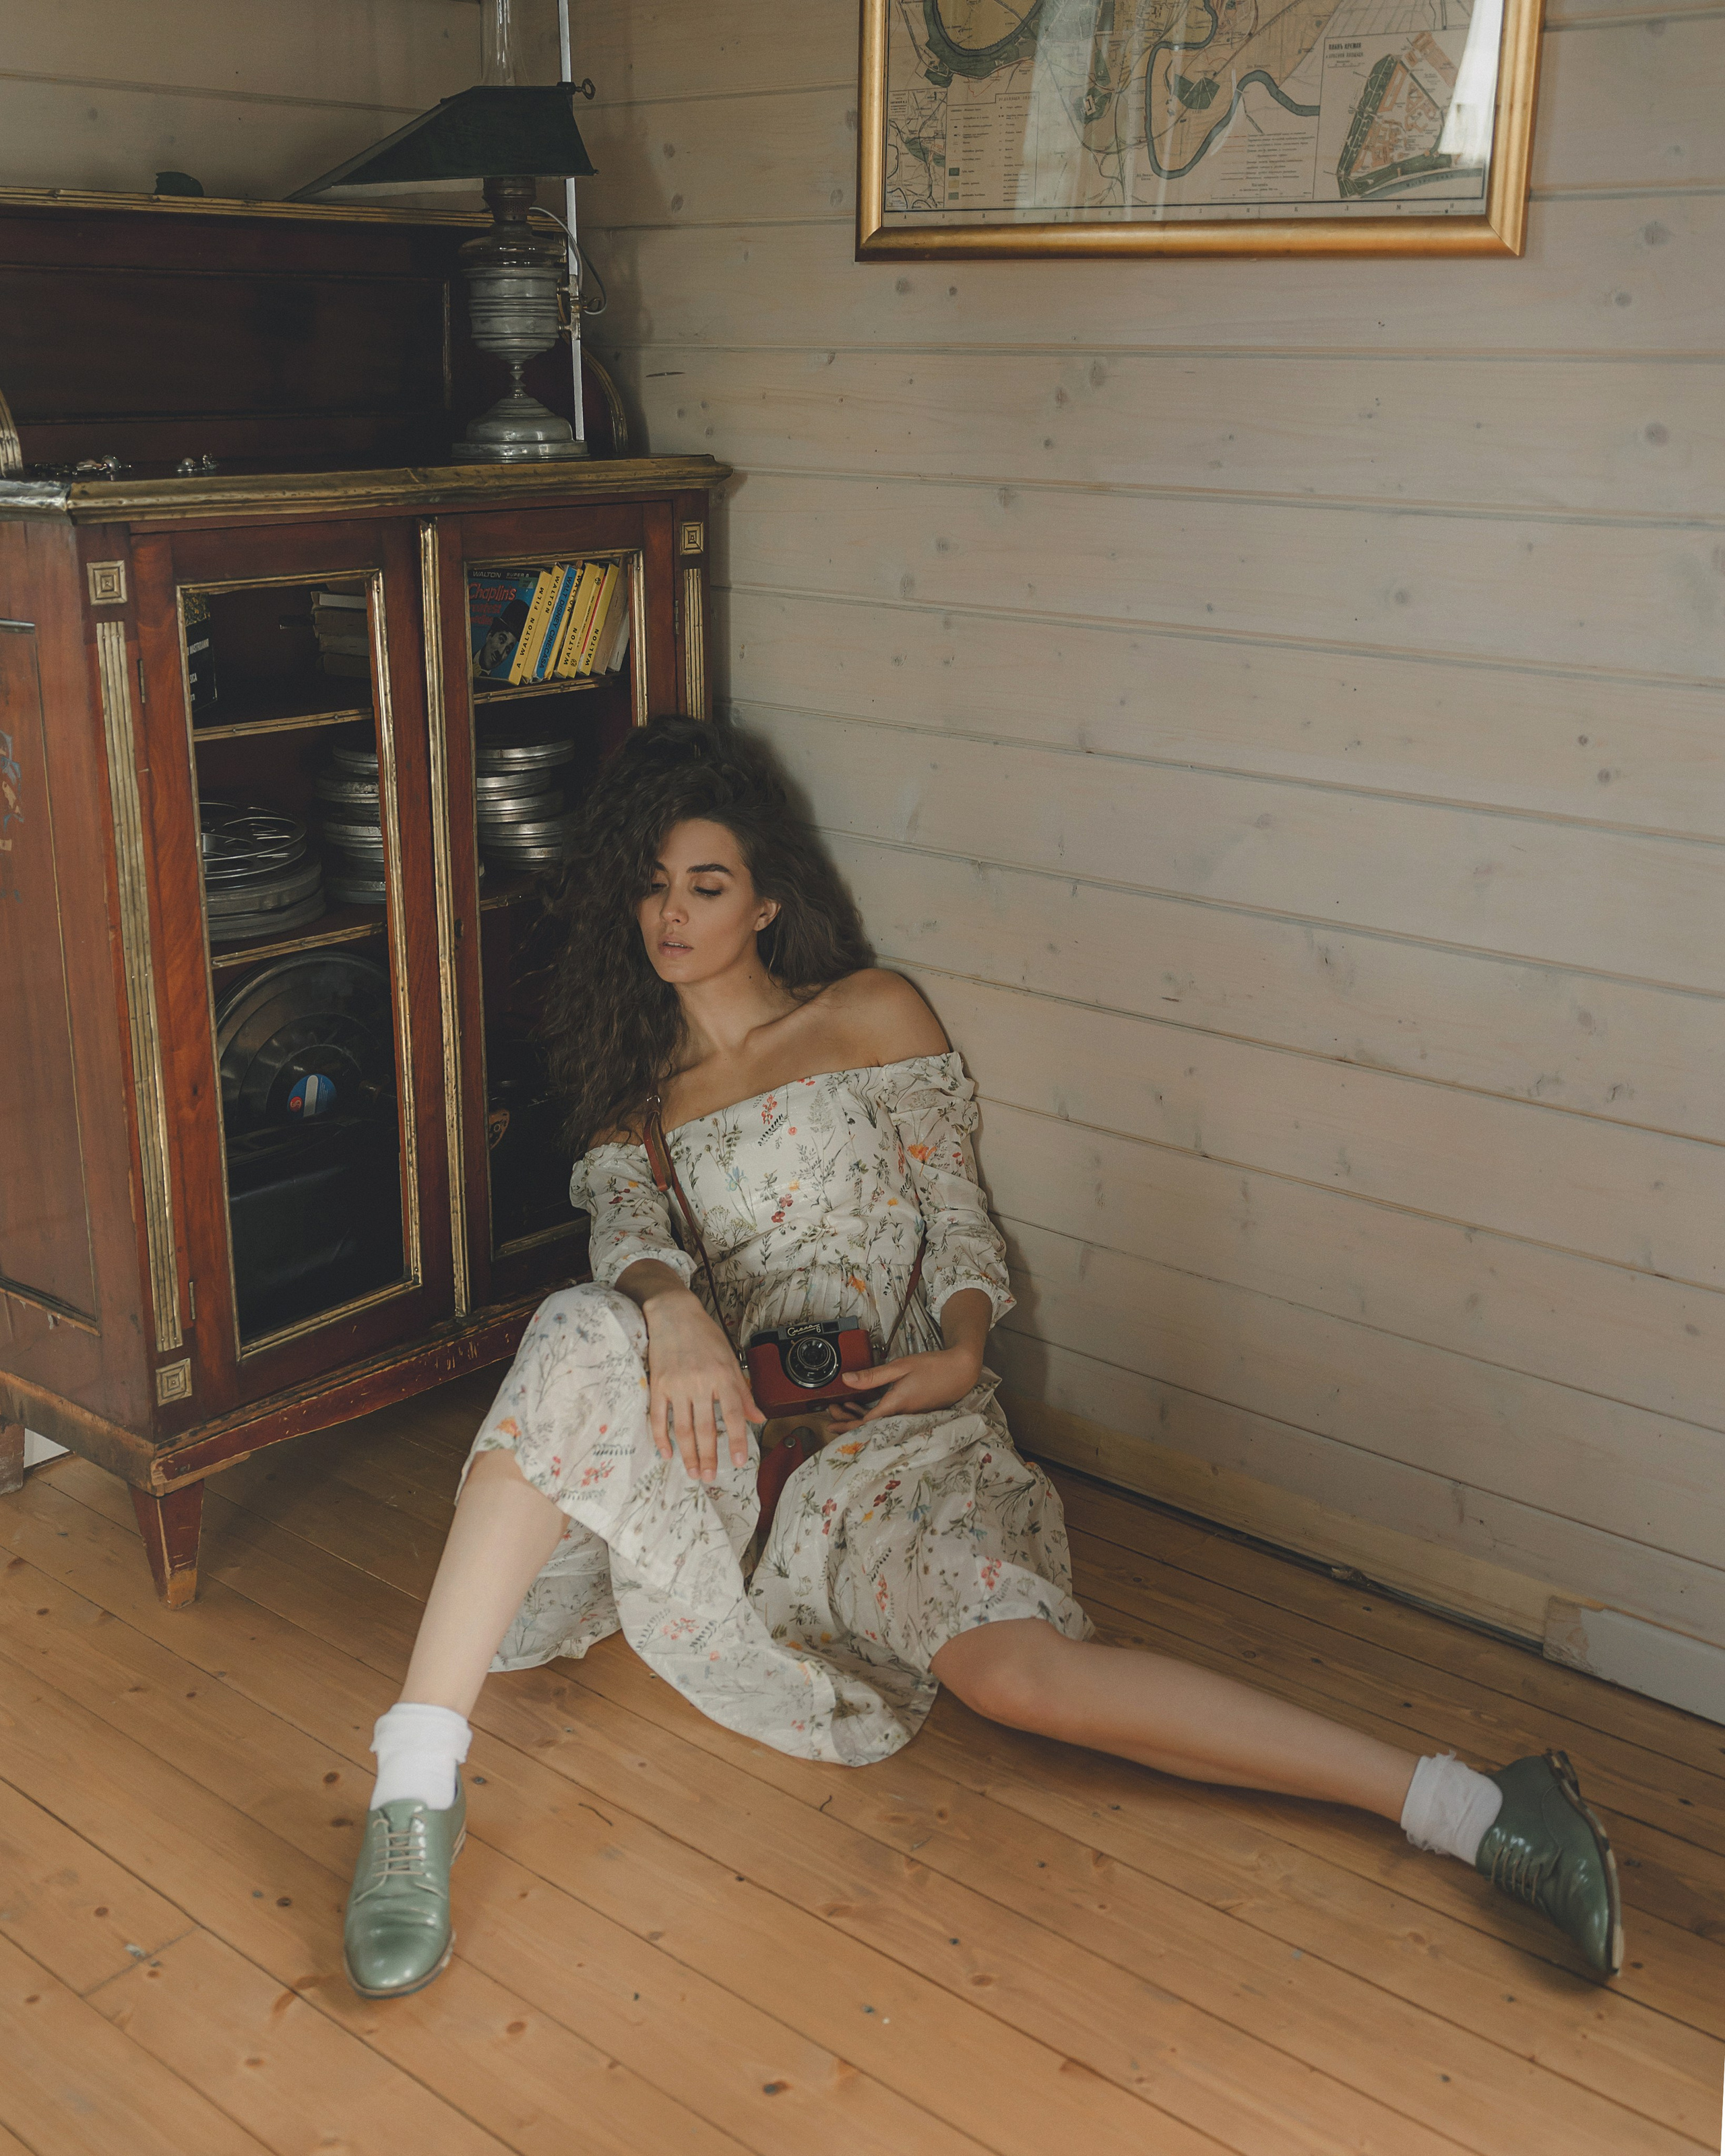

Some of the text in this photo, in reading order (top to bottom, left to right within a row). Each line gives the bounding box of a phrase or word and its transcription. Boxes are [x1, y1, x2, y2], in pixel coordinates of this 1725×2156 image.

[545, 575, 560, 613] WALTON
[520, 617, 535, 656] WALTON
[534, 587, 544, 610] FILM
[539, 575, 573, 669] WALT DISNEY CINECASA
[563, 627, 577, 665] WALTON
[585, 629, 600, 666] WALTON
